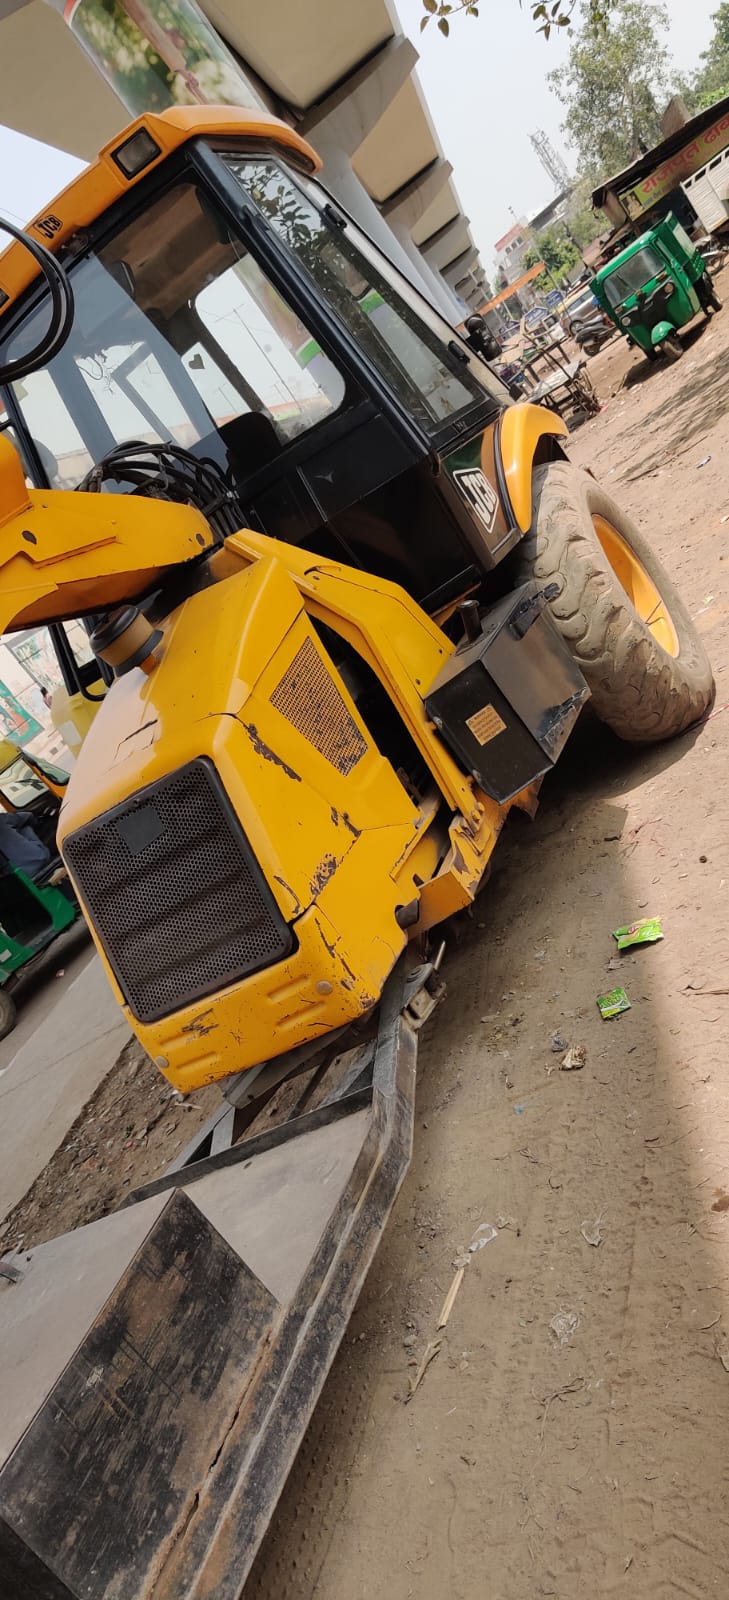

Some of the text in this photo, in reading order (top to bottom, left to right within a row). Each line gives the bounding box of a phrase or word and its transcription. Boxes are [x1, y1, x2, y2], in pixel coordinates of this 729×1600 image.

[641, 142, 700, 194] राजपूत
[37, 216, 61, 240] JCB
[459, 472, 497, 525] JCB
